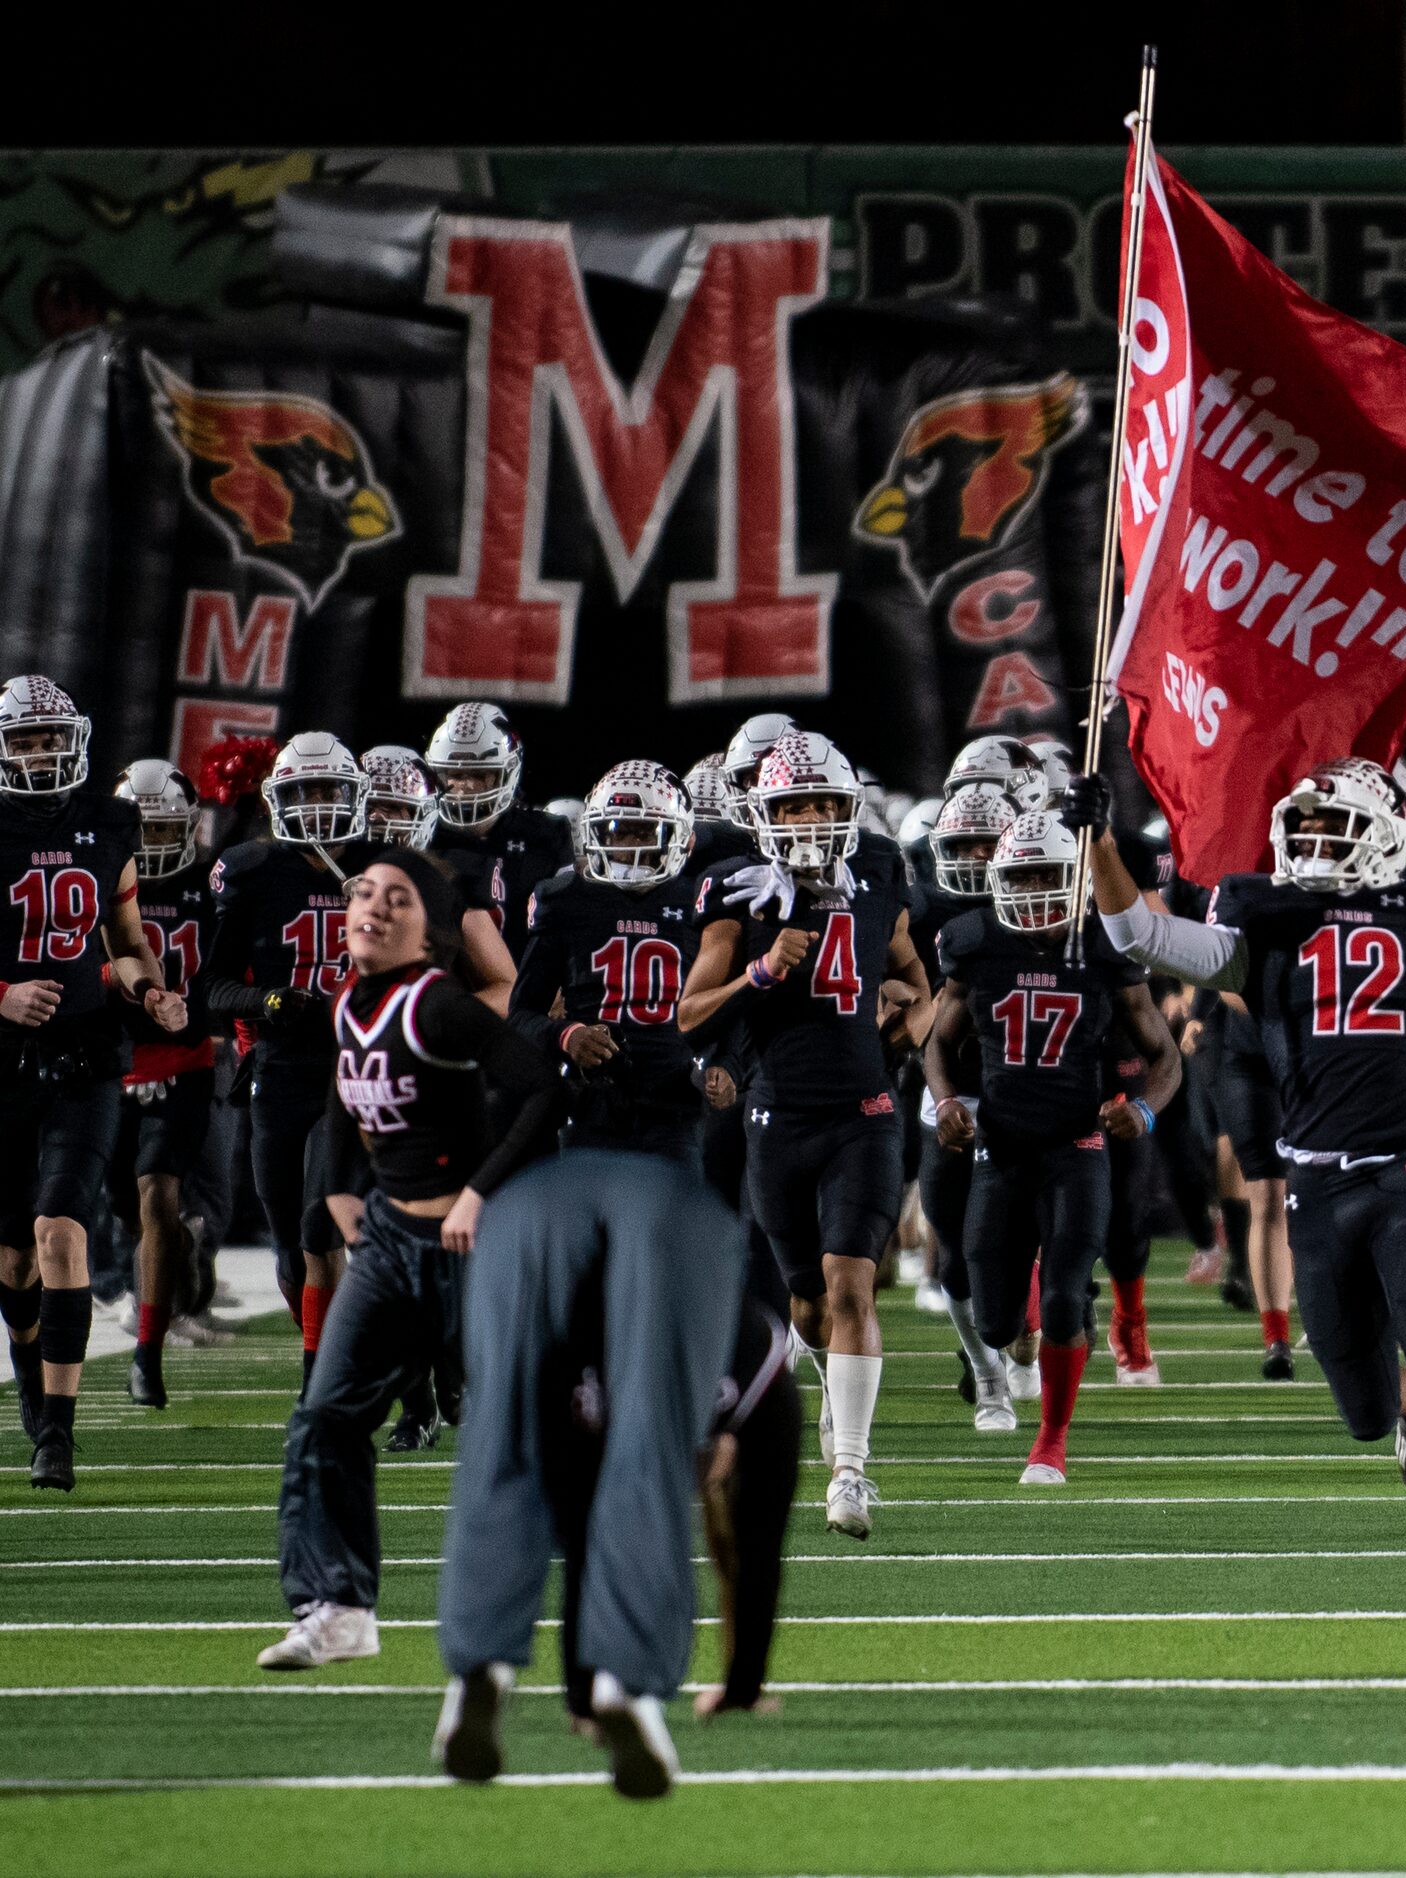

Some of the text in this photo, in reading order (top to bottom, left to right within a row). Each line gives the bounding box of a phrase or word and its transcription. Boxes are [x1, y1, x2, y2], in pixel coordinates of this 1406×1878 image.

[403, 216, 840, 706] M
[1194, 367, 1367, 524] time
[32, 851, 73, 865] CARDS
[10, 868, 98, 963] 19
[282, 910, 352, 996] 15
[617, 919, 658, 935] CARDS
[591, 936, 682, 1026] 10
[810, 912, 862, 1015] 4
[1016, 972, 1057, 988] CARDS
[1299, 923, 1406, 1037] 12
[992, 990, 1083, 1067] 17
